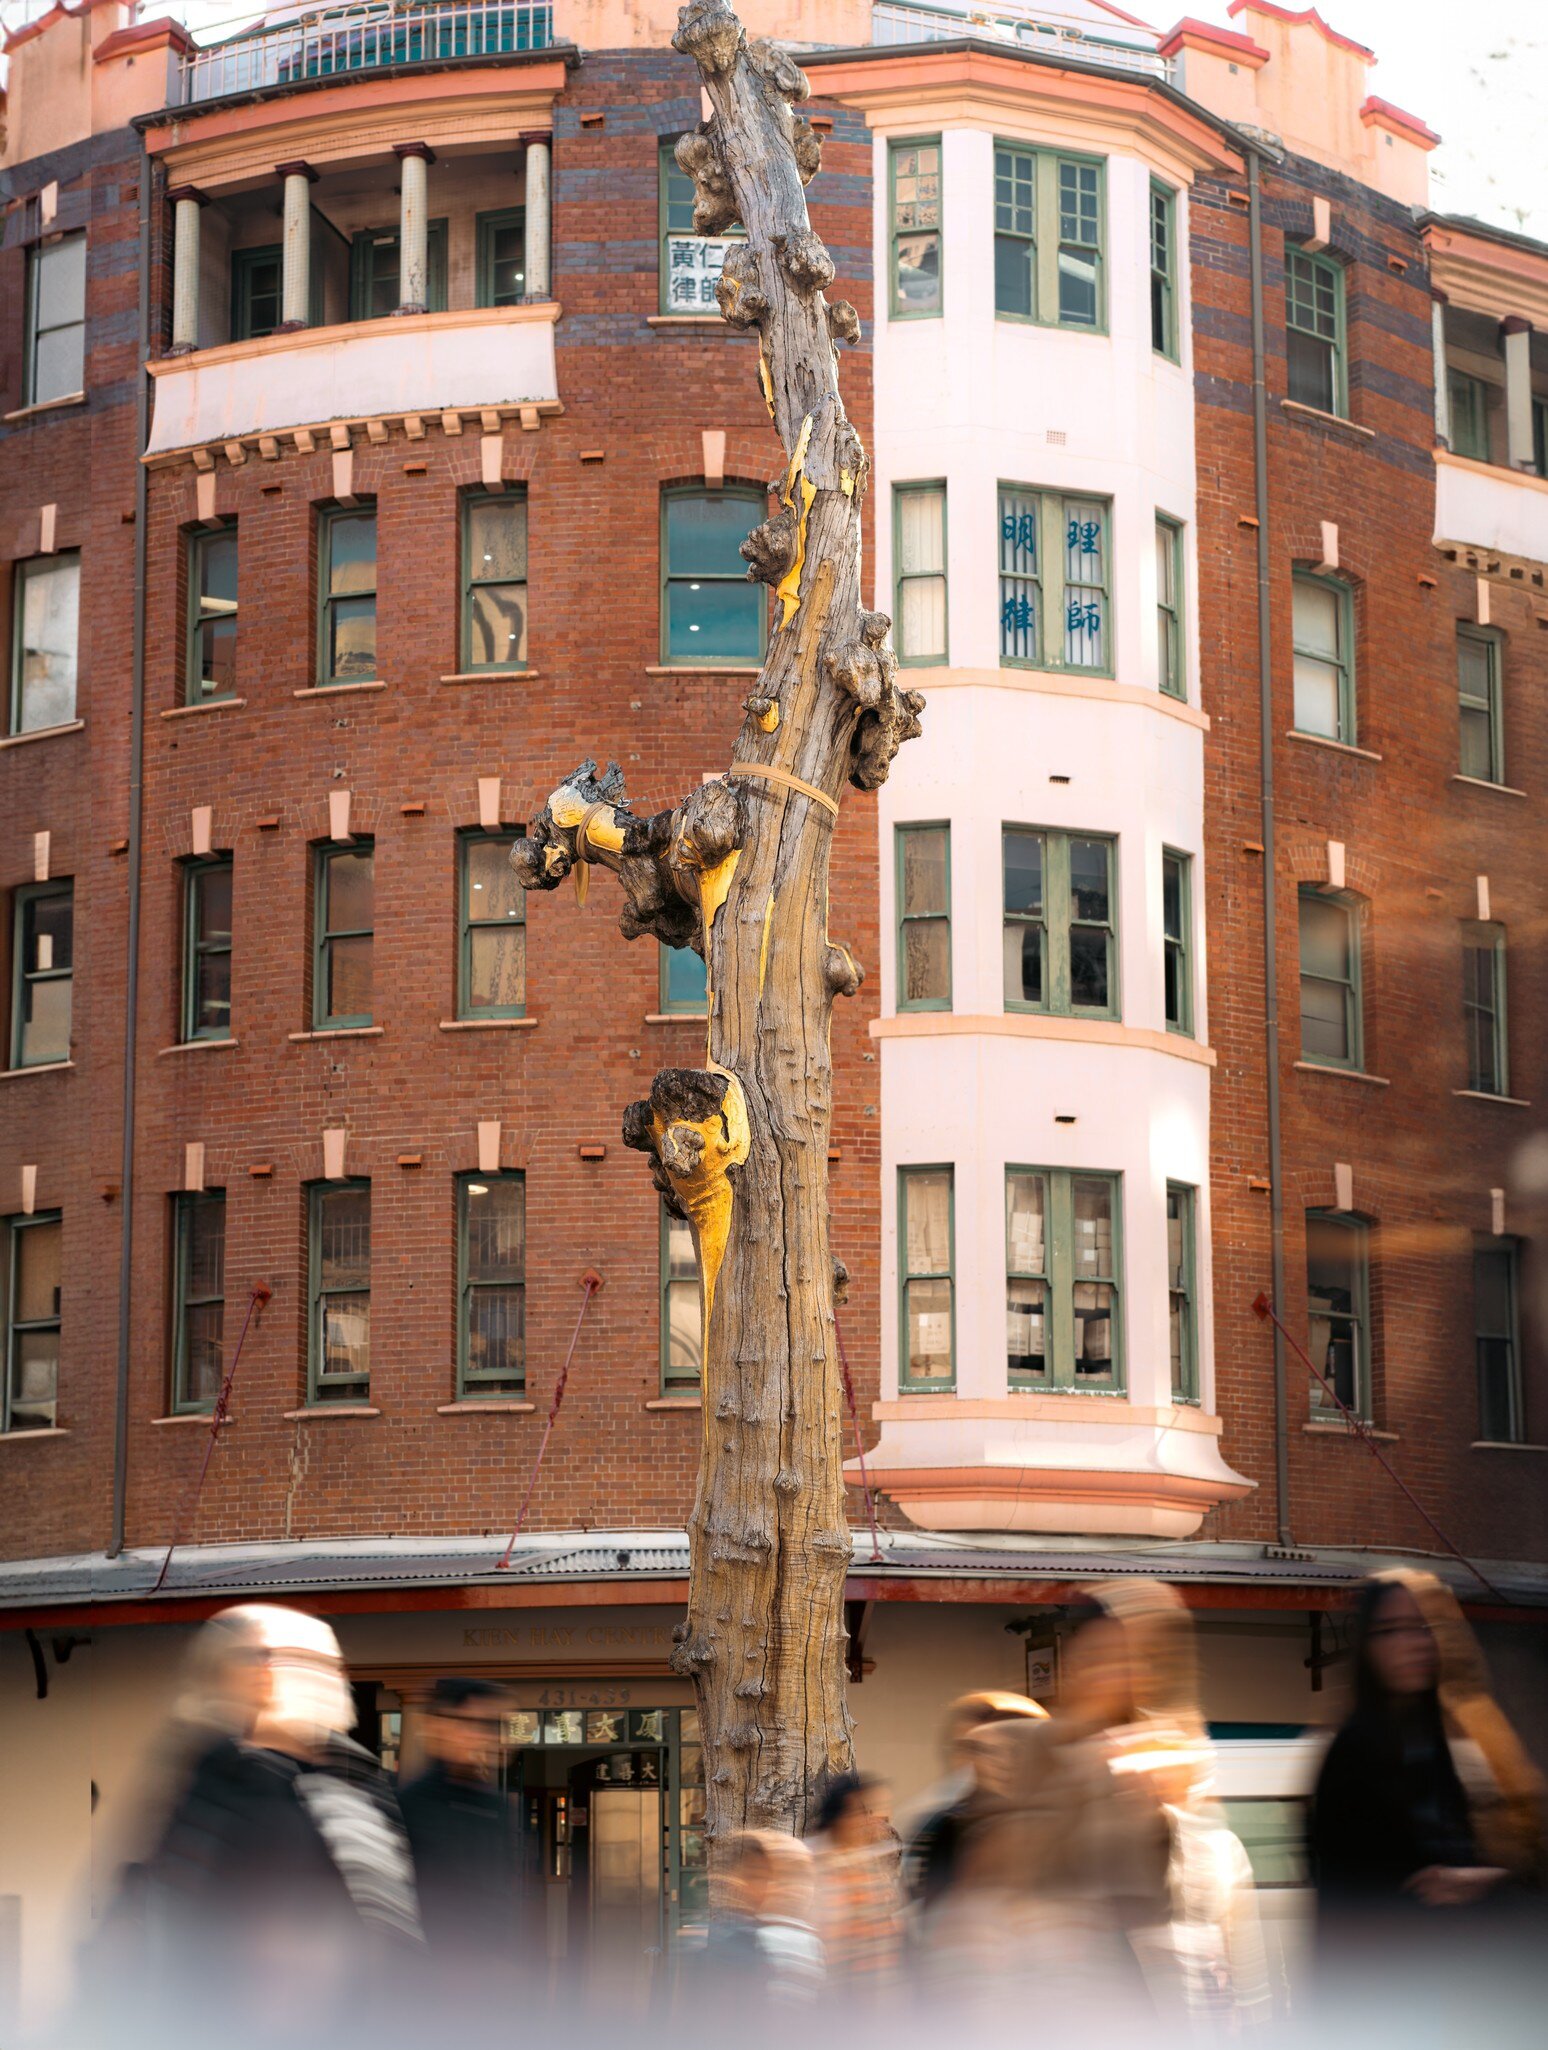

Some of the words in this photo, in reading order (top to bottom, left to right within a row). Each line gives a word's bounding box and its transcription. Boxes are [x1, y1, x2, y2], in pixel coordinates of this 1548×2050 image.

[671, 241, 749, 268] 黃仁
[1001, 514, 1100, 554] 明理
[1001, 594, 1100, 641] 律師
[463, 1628, 520, 1647] KIEN
[530, 1627, 577, 1647] HAY
[539, 1688, 631, 1706] 431-439
